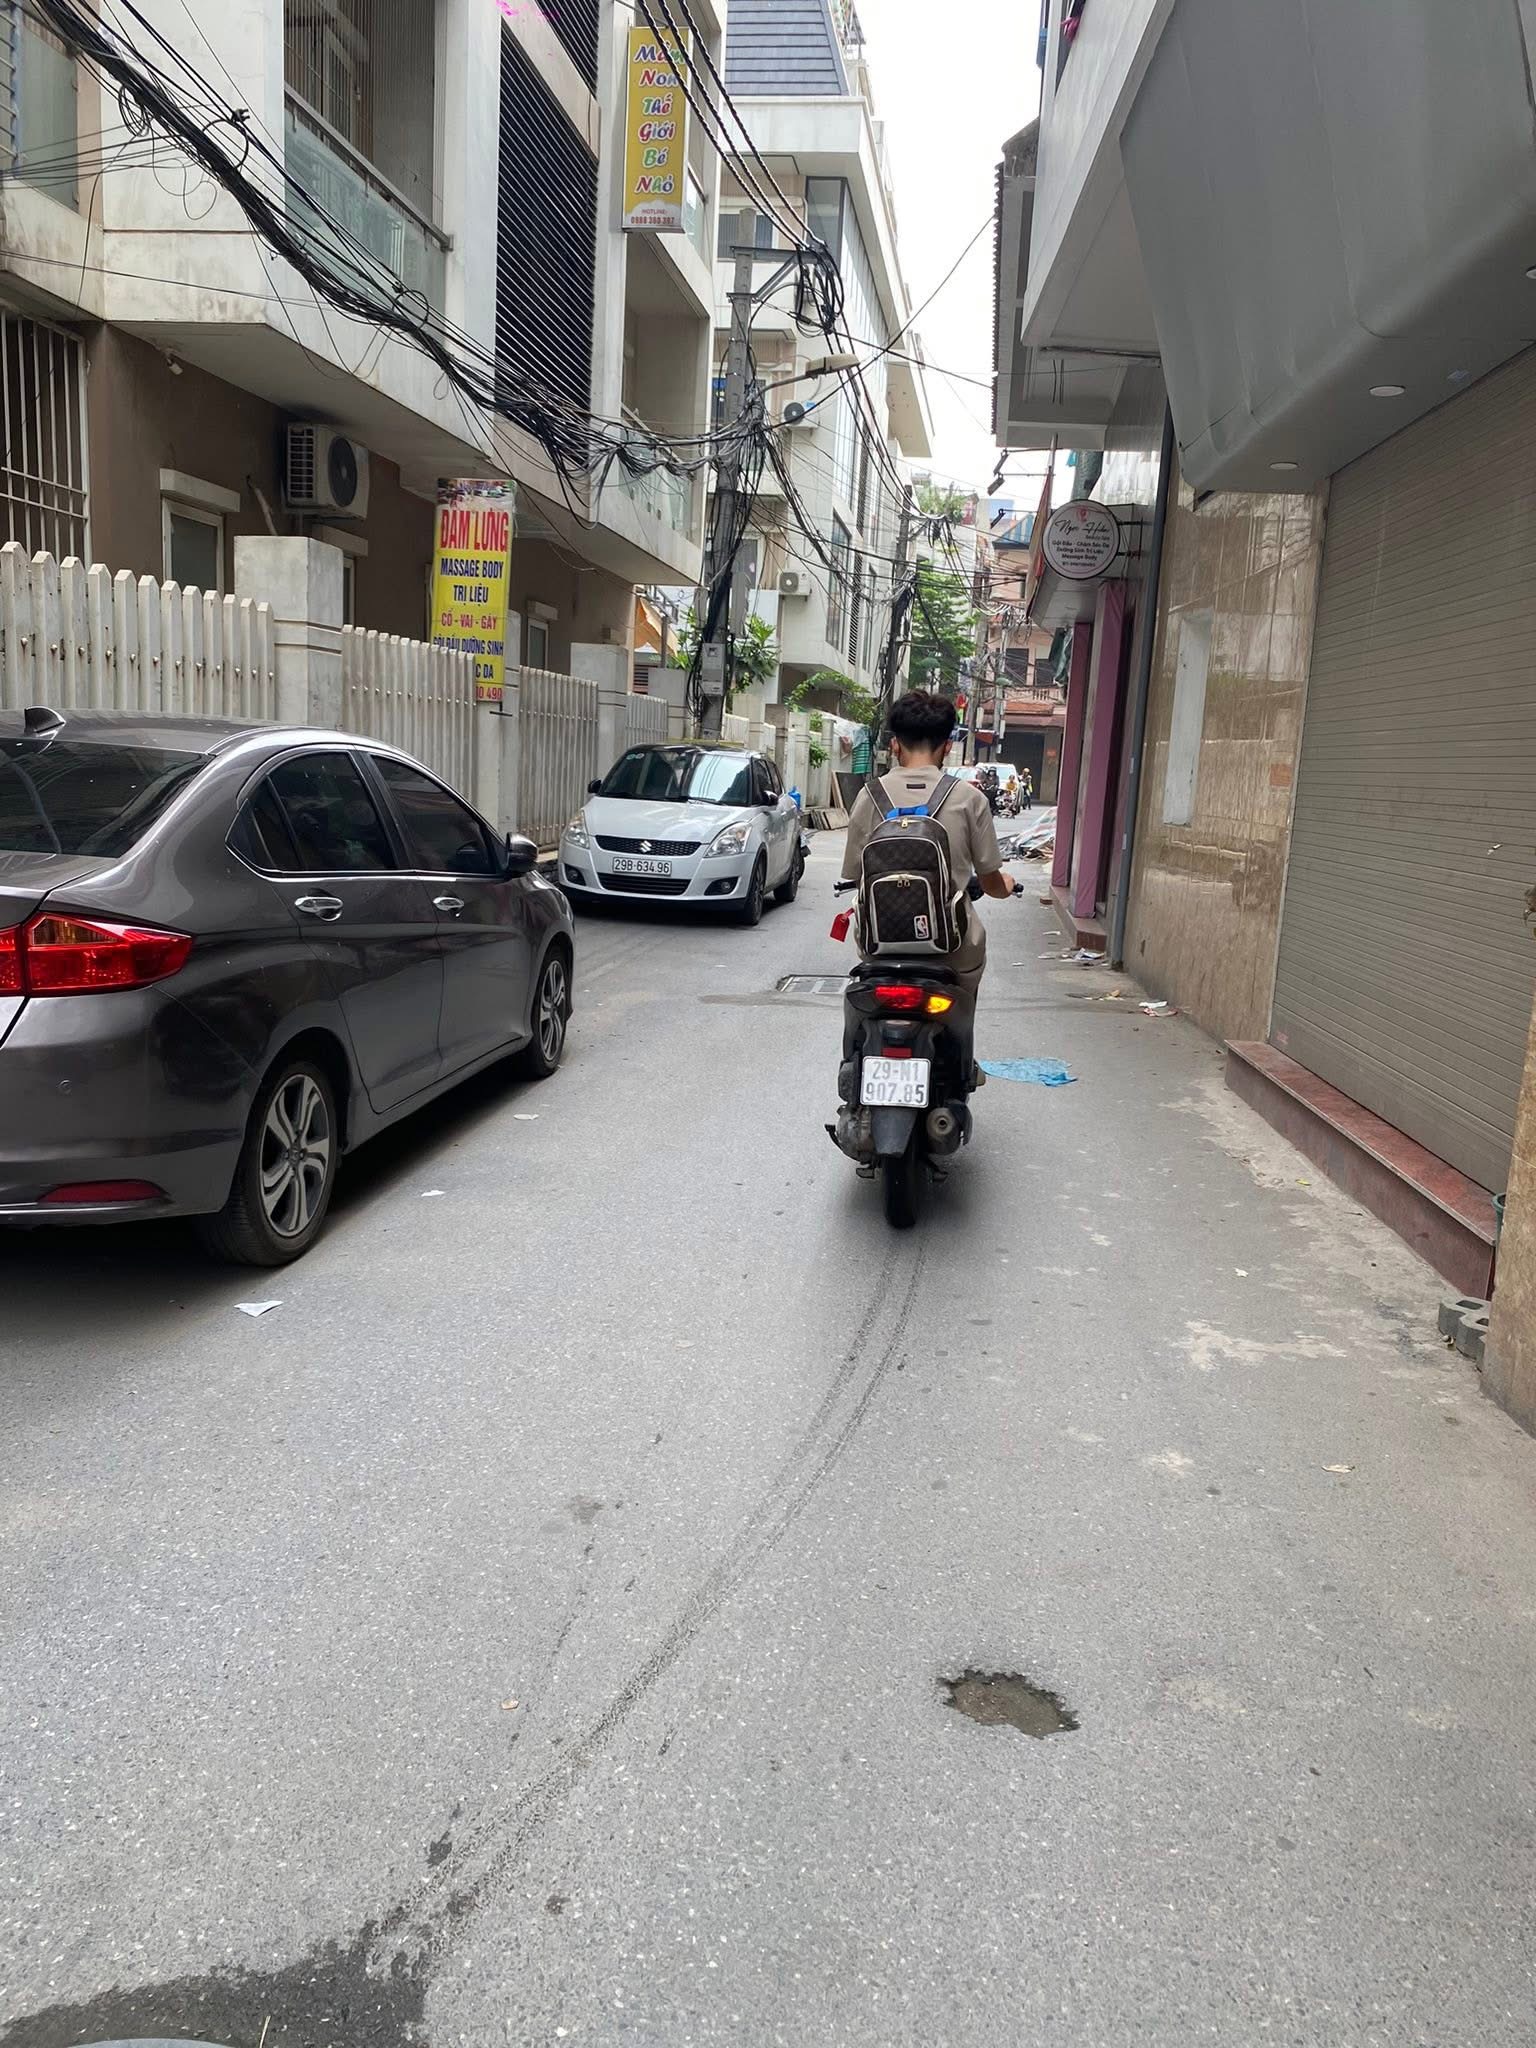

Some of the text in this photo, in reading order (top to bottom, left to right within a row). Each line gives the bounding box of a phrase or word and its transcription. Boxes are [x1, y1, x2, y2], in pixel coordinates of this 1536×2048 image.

[642, 94, 672, 115] Thế
[639, 120, 675, 142] Giới
[642, 147, 667, 168] Bé
[636, 174, 673, 194] Nhỏ
[440, 557, 503, 579] MASSAGE BODY
[453, 583, 488, 607] TRỊ LIỆU
[460, 614, 473, 628] VAI
[487, 640, 504, 656] SINH
[483, 664, 494, 679] DA
[615, 859, 670, 873] 29B-634.96
[865, 1082, 925, 1104] 907.85
